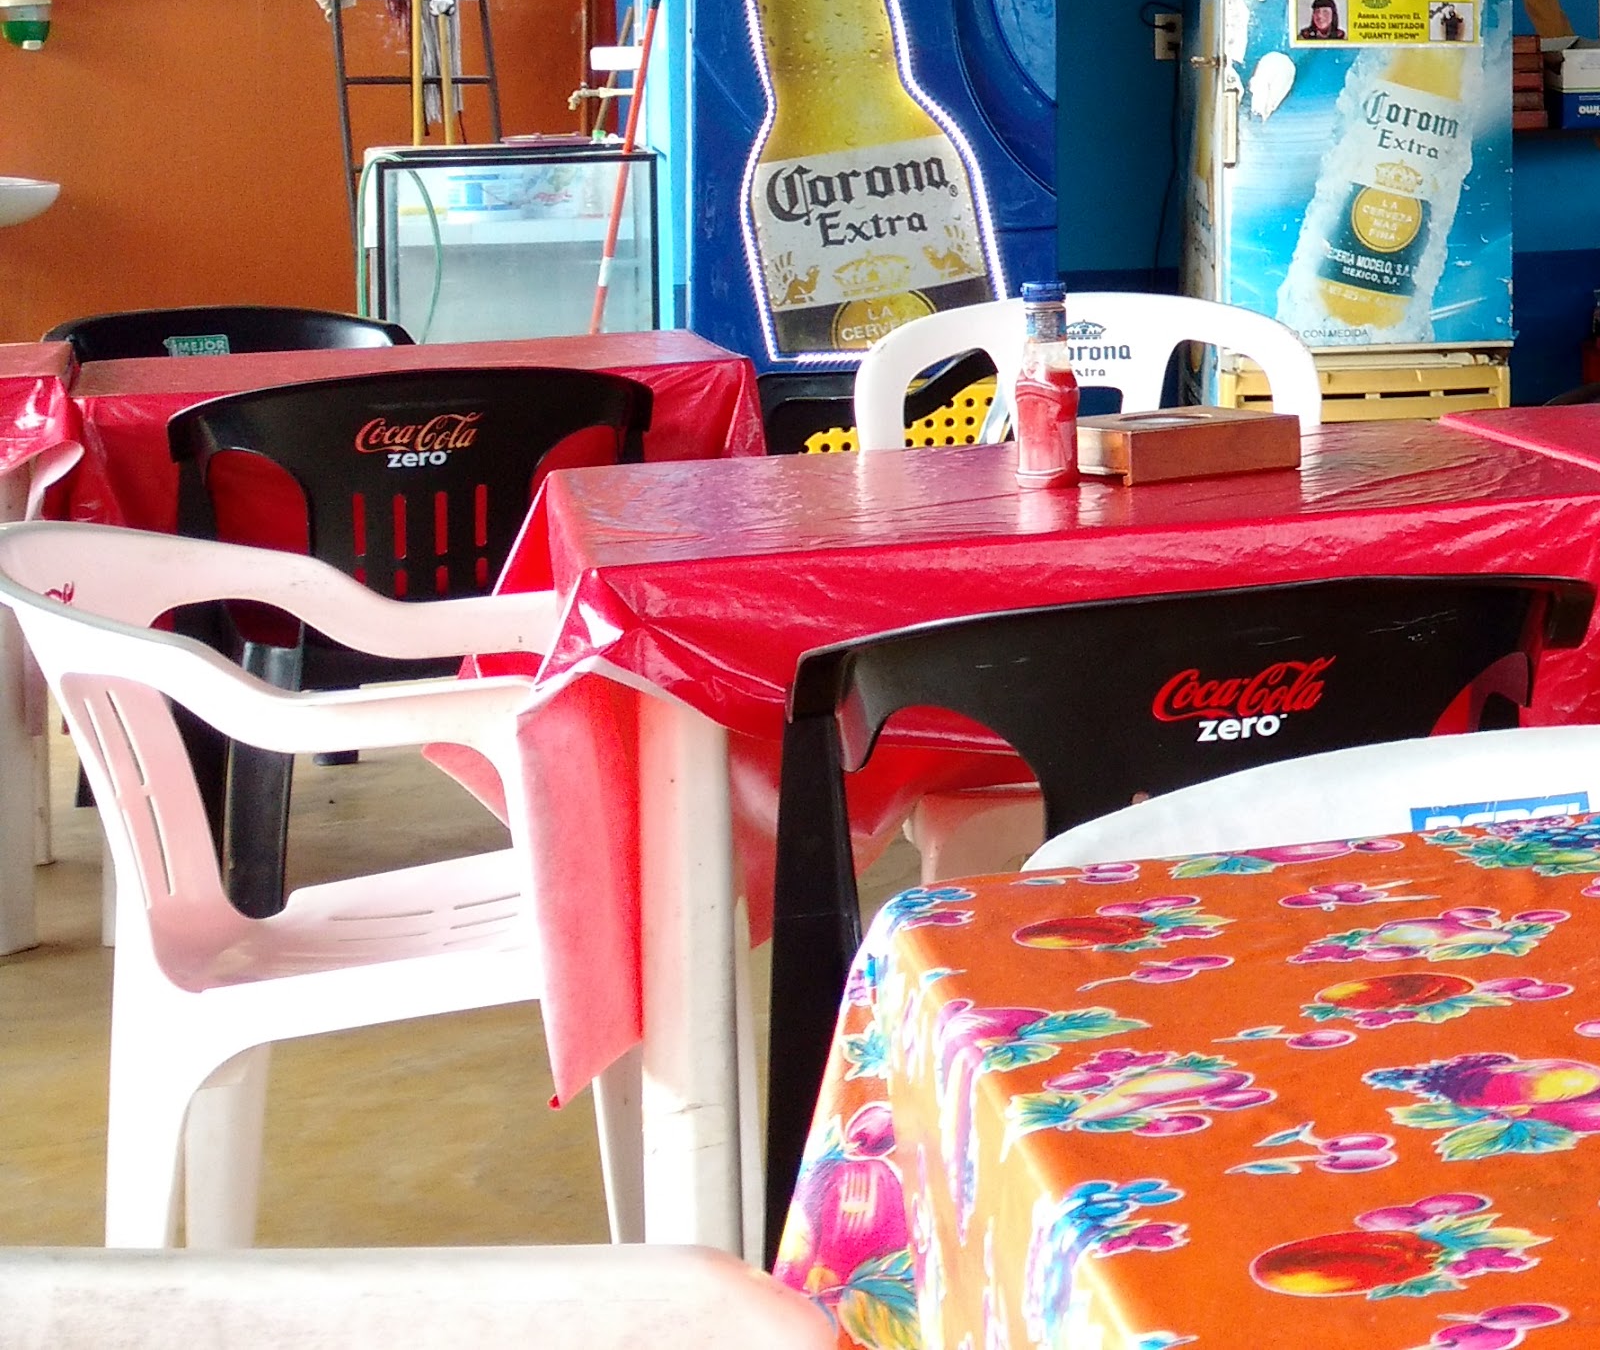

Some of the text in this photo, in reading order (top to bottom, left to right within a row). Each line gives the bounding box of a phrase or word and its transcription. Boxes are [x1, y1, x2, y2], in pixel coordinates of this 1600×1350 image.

[1377, 129, 1440, 159] Extra
[766, 155, 950, 225] Corona
[816, 211, 928, 247] Extra
[867, 305, 894, 320] LA
[1075, 368, 1106, 377] xtra
[355, 412, 483, 454] Coca-Cola
[387, 450, 448, 468] zero
[1152, 655, 1336, 722] Coca-Cola
[1197, 714, 1281, 742] zero
